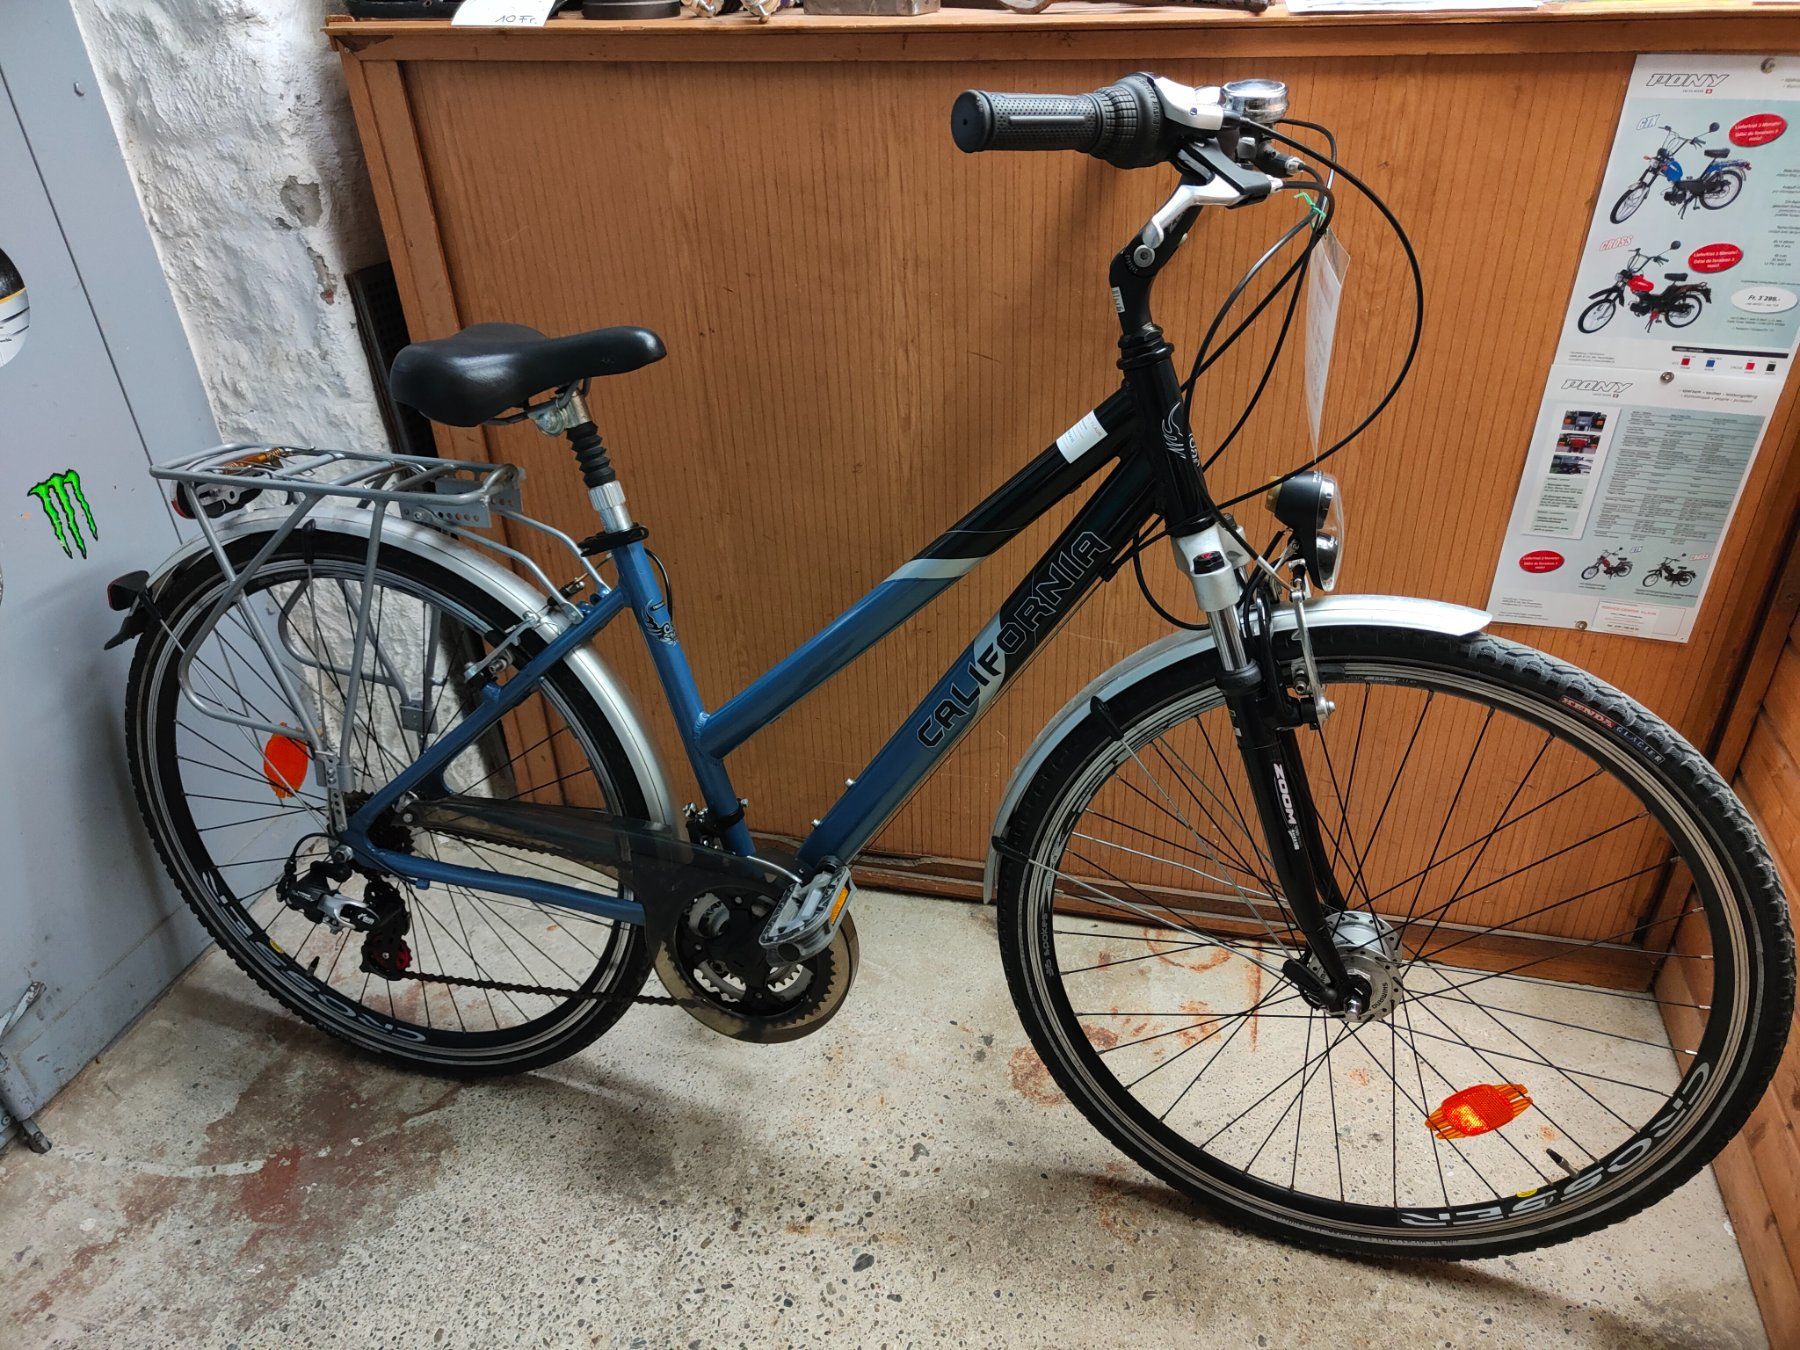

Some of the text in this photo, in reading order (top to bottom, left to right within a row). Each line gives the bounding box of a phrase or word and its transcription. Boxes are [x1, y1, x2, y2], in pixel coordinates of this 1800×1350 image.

[495, 14, 517, 23] 10
[1645, 73, 1730, 88] PONY
[1600, 235, 1634, 251] CROSS
[1561, 378, 1634, 393] PONY
[916, 530, 1113, 750] CALIFORNIA
[1561, 696, 1664, 764] KENDA GLACIER
[1273, 762, 1298, 826] ZOOM
[202, 871, 427, 1042] CROSSER
[1372, 982, 1389, 1009] SHIMANO
[1400, 1061, 1710, 1227] CROSSER
